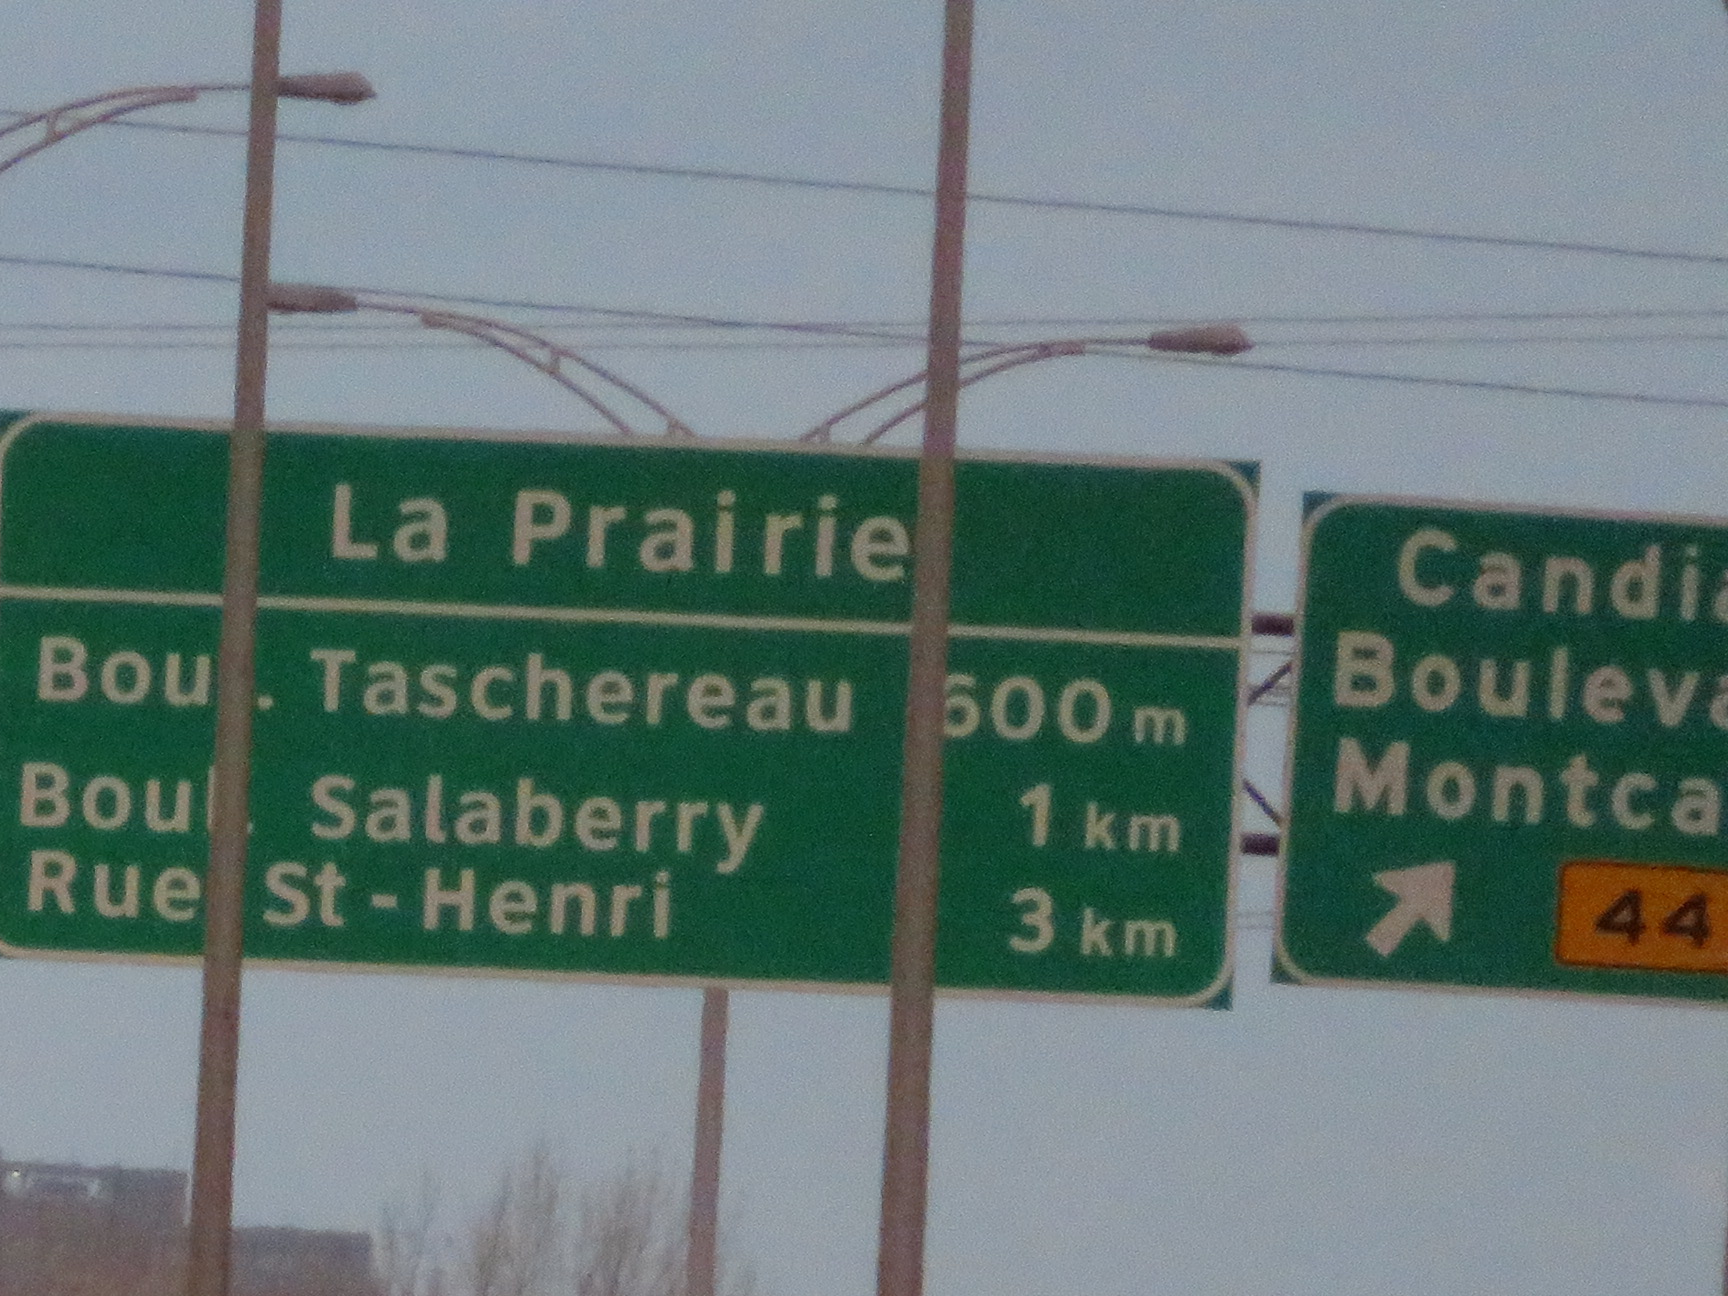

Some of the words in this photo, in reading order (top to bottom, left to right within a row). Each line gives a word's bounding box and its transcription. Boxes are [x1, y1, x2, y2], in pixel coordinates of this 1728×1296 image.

[332, 485, 448, 564] La
[512, 489, 910, 582] Prairie
[38, 635, 275, 710] Bou.
[310, 648, 853, 733] Taschereau
[943, 673, 1111, 743] 600
[1134, 705, 1187, 745] m
[310, 774, 764, 874] Salaberry
[1020, 784, 1051, 848] 1
[1083, 802, 1182, 852] km
[1334, 737, 1722, 837] Montca
[28, 849, 201, 922] Rue
[1008, 887, 1054, 953] 3
[1080, 906, 1180, 956] km
[1596, 886, 1712, 948] 44
